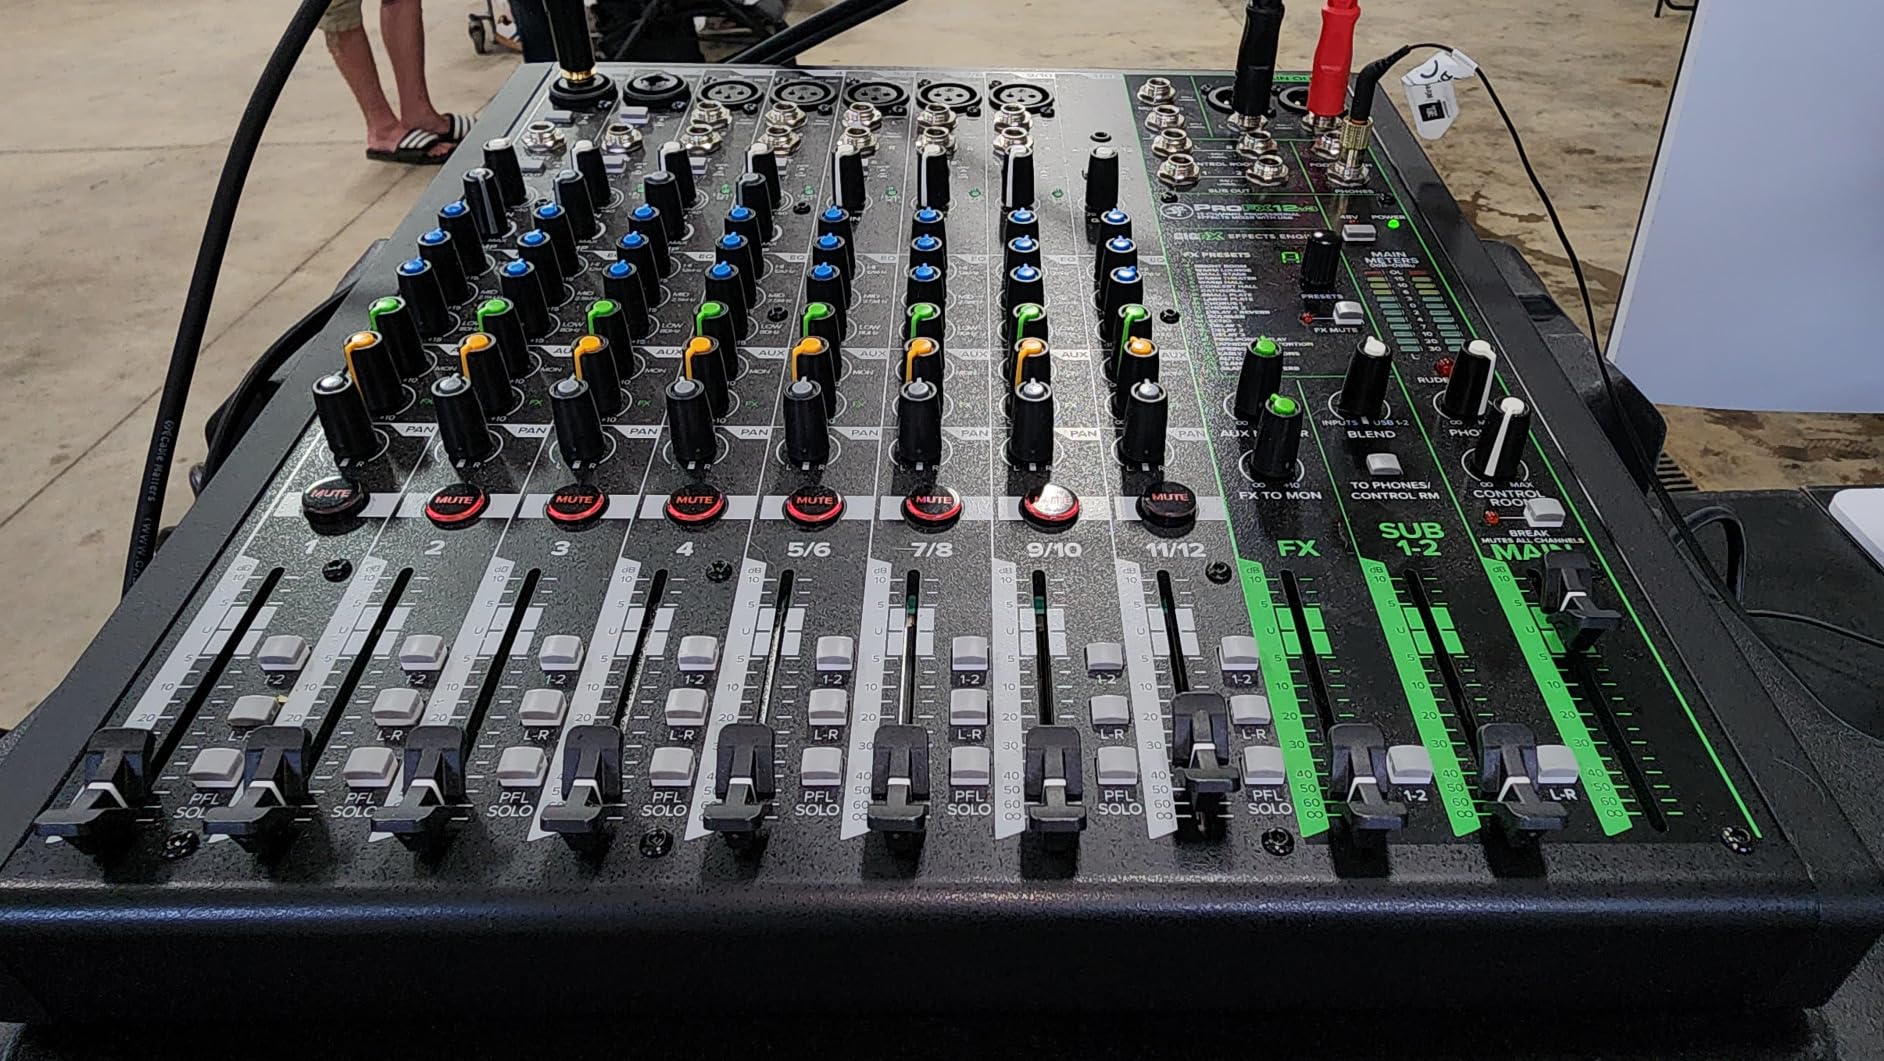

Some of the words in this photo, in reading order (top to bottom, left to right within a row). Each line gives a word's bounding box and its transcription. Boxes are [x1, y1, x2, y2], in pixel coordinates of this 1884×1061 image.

[405, 425, 435, 434] PAN
[517, 426, 547, 435] PAN
[629, 427, 658, 436] PAN
[740, 428, 769, 436] PAN
[850, 428, 879, 437] PAN
[961, 429, 989, 438] PAN
[1070, 429, 1097, 438] PAN
[1178, 429, 1206, 438] PAN
[1220, 430, 1250, 438] AUX
[1347, 430, 1396, 439] BLEND
[1350, 481, 1370, 490] TO
[1372, 481, 1431, 490] PHONES/
[310, 488, 352, 498] MUTE
[1151, 492, 1189, 502] MUTE
[1239, 491, 1260, 500] FX
[1261, 491, 1284, 500] TO
[1286, 491, 1322, 500] MON
[1351, 491, 1418, 500] CONTROL
[1419, 491, 1441, 500] RM
[1473, 489, 1546, 498] CONTROL
[434, 496, 474, 505] MUTE
[555, 495, 594, 505] MUTE
[676, 495, 714, 505] MUTE
[796, 495, 834, 505] MUTE
[915, 495, 953, 505] MUTE
[1378, 522, 1445, 539] SUB
[1508, 529, 1550, 537] BREAK
[304, 539, 320, 554] 1
[424, 540, 446, 555] 2
[551, 541, 571, 556] 3
[675, 541, 694, 556] 4
[787, 542, 831, 557] 5/6
[911, 542, 953, 557] 7/8
[1027, 542, 1082, 558] 9/10
[1146, 542, 1207, 558] 11/12
[1277, 539, 1321, 557] FX
[1396, 539, 1442, 556] 1-2
[263, 675, 285, 685] 1-2
[405, 675, 426, 685] 1-2
[545, 675, 566, 684] 1-2
[684, 675, 705, 684] 1-2
[822, 675, 843, 684] 1-2
[960, 675, 981, 684] 1-2
[1097, 675, 1117, 684] 1-2
[1231, 675, 1252, 685] 1-2
[1274, 682, 1289, 690] 10
[1411, 682, 1426, 690] 10
[1282, 711, 1298, 720] 20
[1421, 711, 1438, 720] 20
[1559, 710, 1577, 719] 20
[376, 730, 402, 741] L-R
[523, 730, 549, 740] L-R
[669, 730, 695, 740] L-R
[814, 730, 839, 740] L-R
[957, 730, 982, 740] L-R
[1100, 729, 1124, 740] L-R
[1242, 729, 1267, 740] L-R
[1289, 740, 1305, 749] 30
[1431, 739, 1448, 748] 30
[1572, 738, 1590, 748] 30
[1296, 769, 1313, 778] 40
[1442, 769, 1459, 778] 40
[1587, 768, 1604, 777] 40
[1300, 784, 1317, 793] 50
[1446, 783, 1464, 793] 50
[1593, 783, 1611, 792] 50
[188, 793, 220, 805] PFL
[344, 792, 376, 804] PFL
[499, 791, 530, 804] PFL
[652, 791, 682, 803] PFL
[804, 790, 834, 802] PFL
[955, 790, 985, 802] PFL
[1104, 790, 1131, 802] PFL
[1252, 789, 1283, 801] PFL
[1403, 790, 1429, 802] 1-2
[1549, 788, 1578, 801] L-R
[1303, 798, 1321, 807] 60
[1452, 797, 1469, 807] 60
[1600, 797, 1618, 806] 60
[172, 806, 206, 819] SOL
[486, 805, 533, 817] SOLO
[641, 804, 687, 817] SOLO
[795, 804, 840, 816] SOLO
[947, 803, 992, 816] SOLO
[1098, 803, 1143, 816] SOLO
[1247, 802, 1293, 816] SOLO
